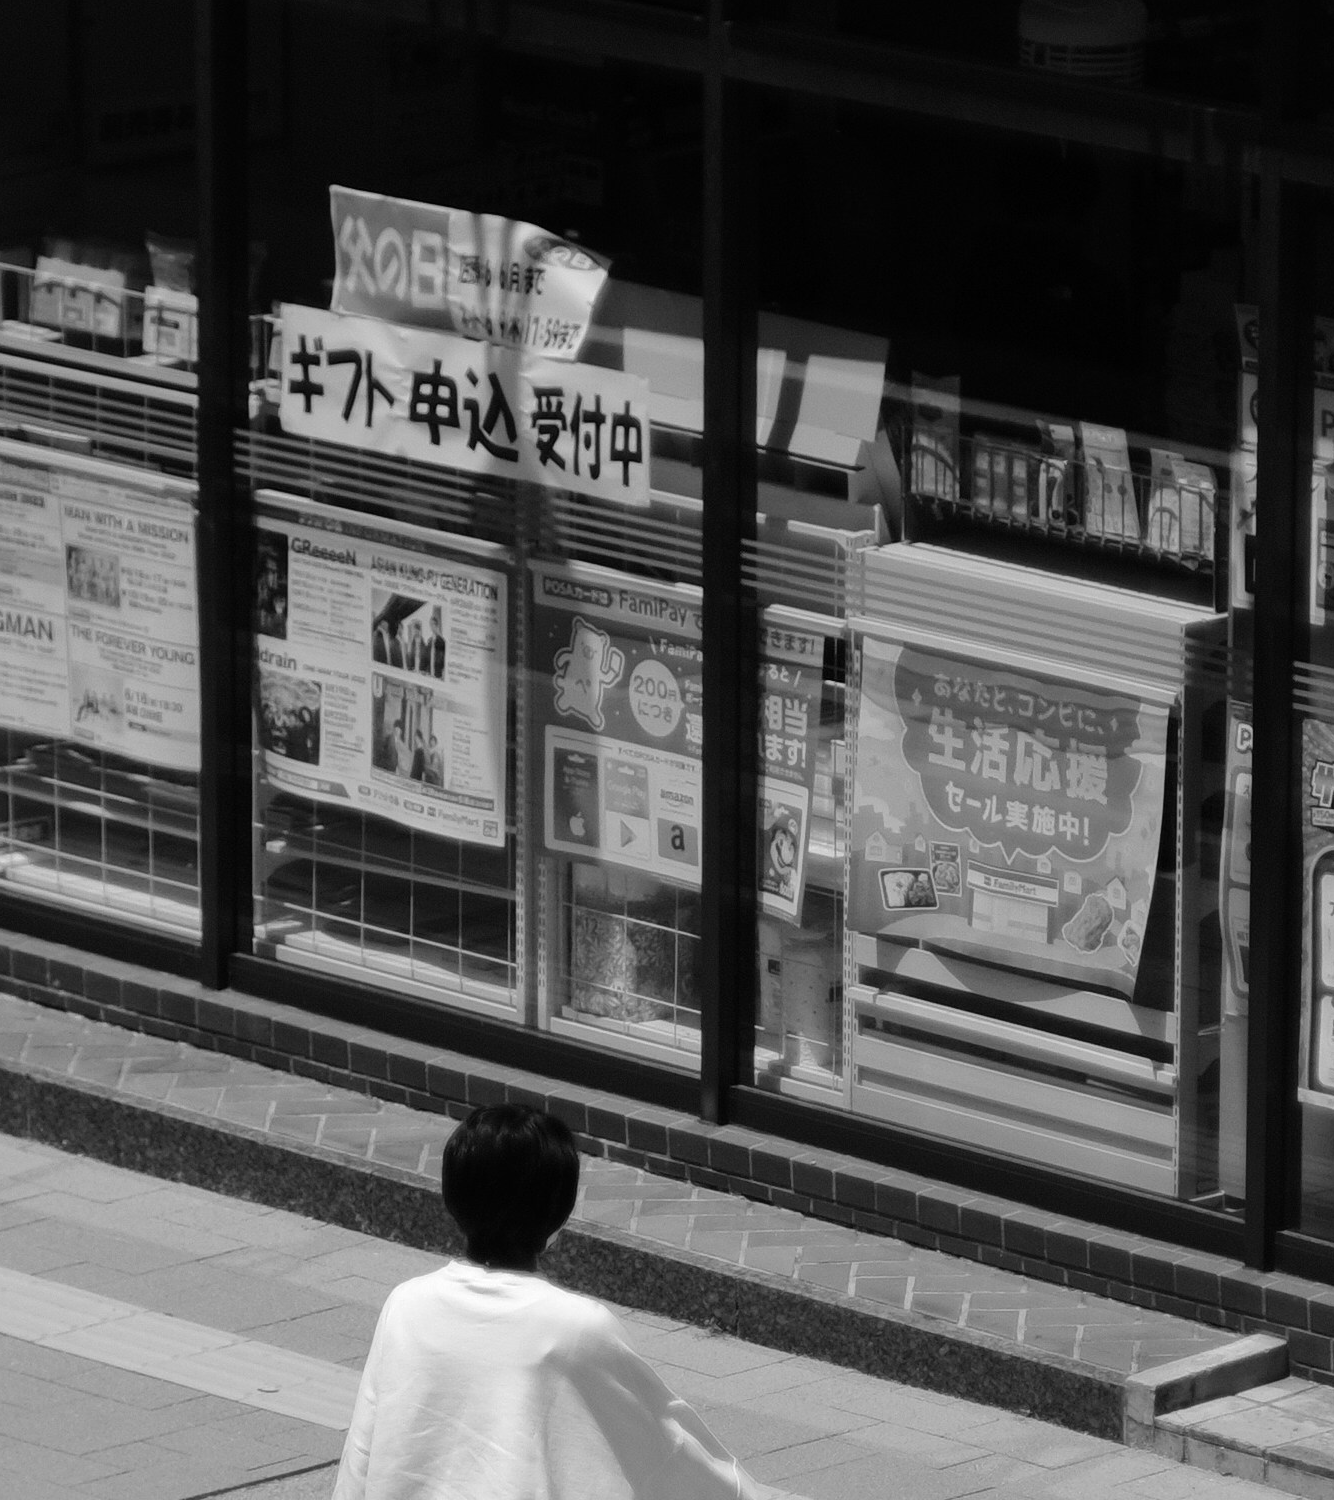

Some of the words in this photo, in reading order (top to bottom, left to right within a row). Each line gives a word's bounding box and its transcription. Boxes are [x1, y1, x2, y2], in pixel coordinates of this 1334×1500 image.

[338, 215, 444, 309] 父の日
[94, 512, 123, 529] WITH
[126, 518, 134, 533] A
[137, 521, 189, 544] MISSION
[440, 572, 498, 600] GENERATION
[70, 623, 93, 641] THE
[94, 630, 146, 654] FOREVER
[150, 646, 196, 666] YOUNG
[927, 706, 1109, 806] 生活応援
[945, 779, 1090, 847] セール実施中!
[670, 823, 686, 852] a
